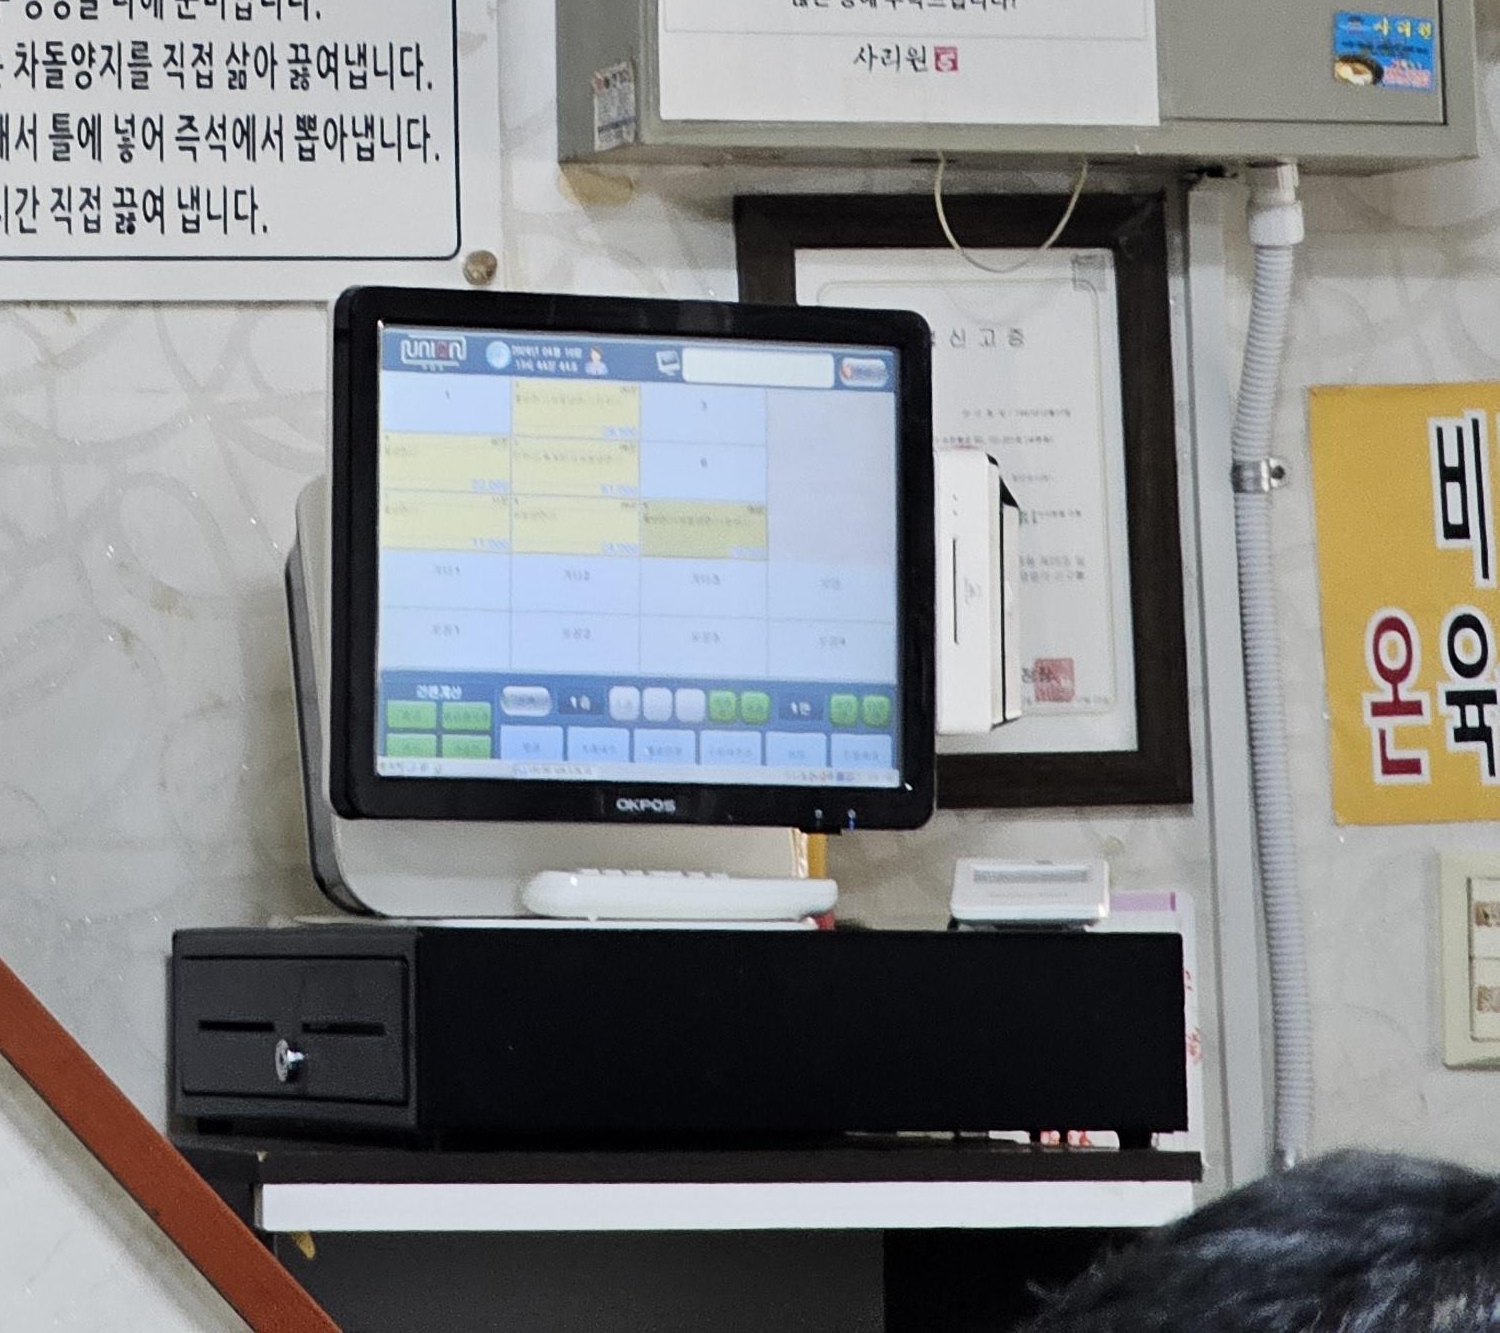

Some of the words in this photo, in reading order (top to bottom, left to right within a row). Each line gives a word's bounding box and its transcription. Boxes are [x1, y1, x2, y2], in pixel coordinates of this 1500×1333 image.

[14, 41, 152, 90] 차돌양지를
[163, 42, 213, 89] 직접
[226, 42, 278, 90] 삶아
[287, 42, 432, 91] 끓여냅니다.
[853, 43, 929, 73] 사리원
[49, 113, 101, 162] 틀에
[115, 114, 163, 163] 넣어
[175, 114, 283, 162] 즉석에서
[294, 114, 439, 163] 뽑아냅니다.
[50, 185, 100, 234] 직접
[113, 186, 164, 235] 끓여
[178, 186, 267, 235] 냅니다.
[616, 798, 676, 813] OKPOS
